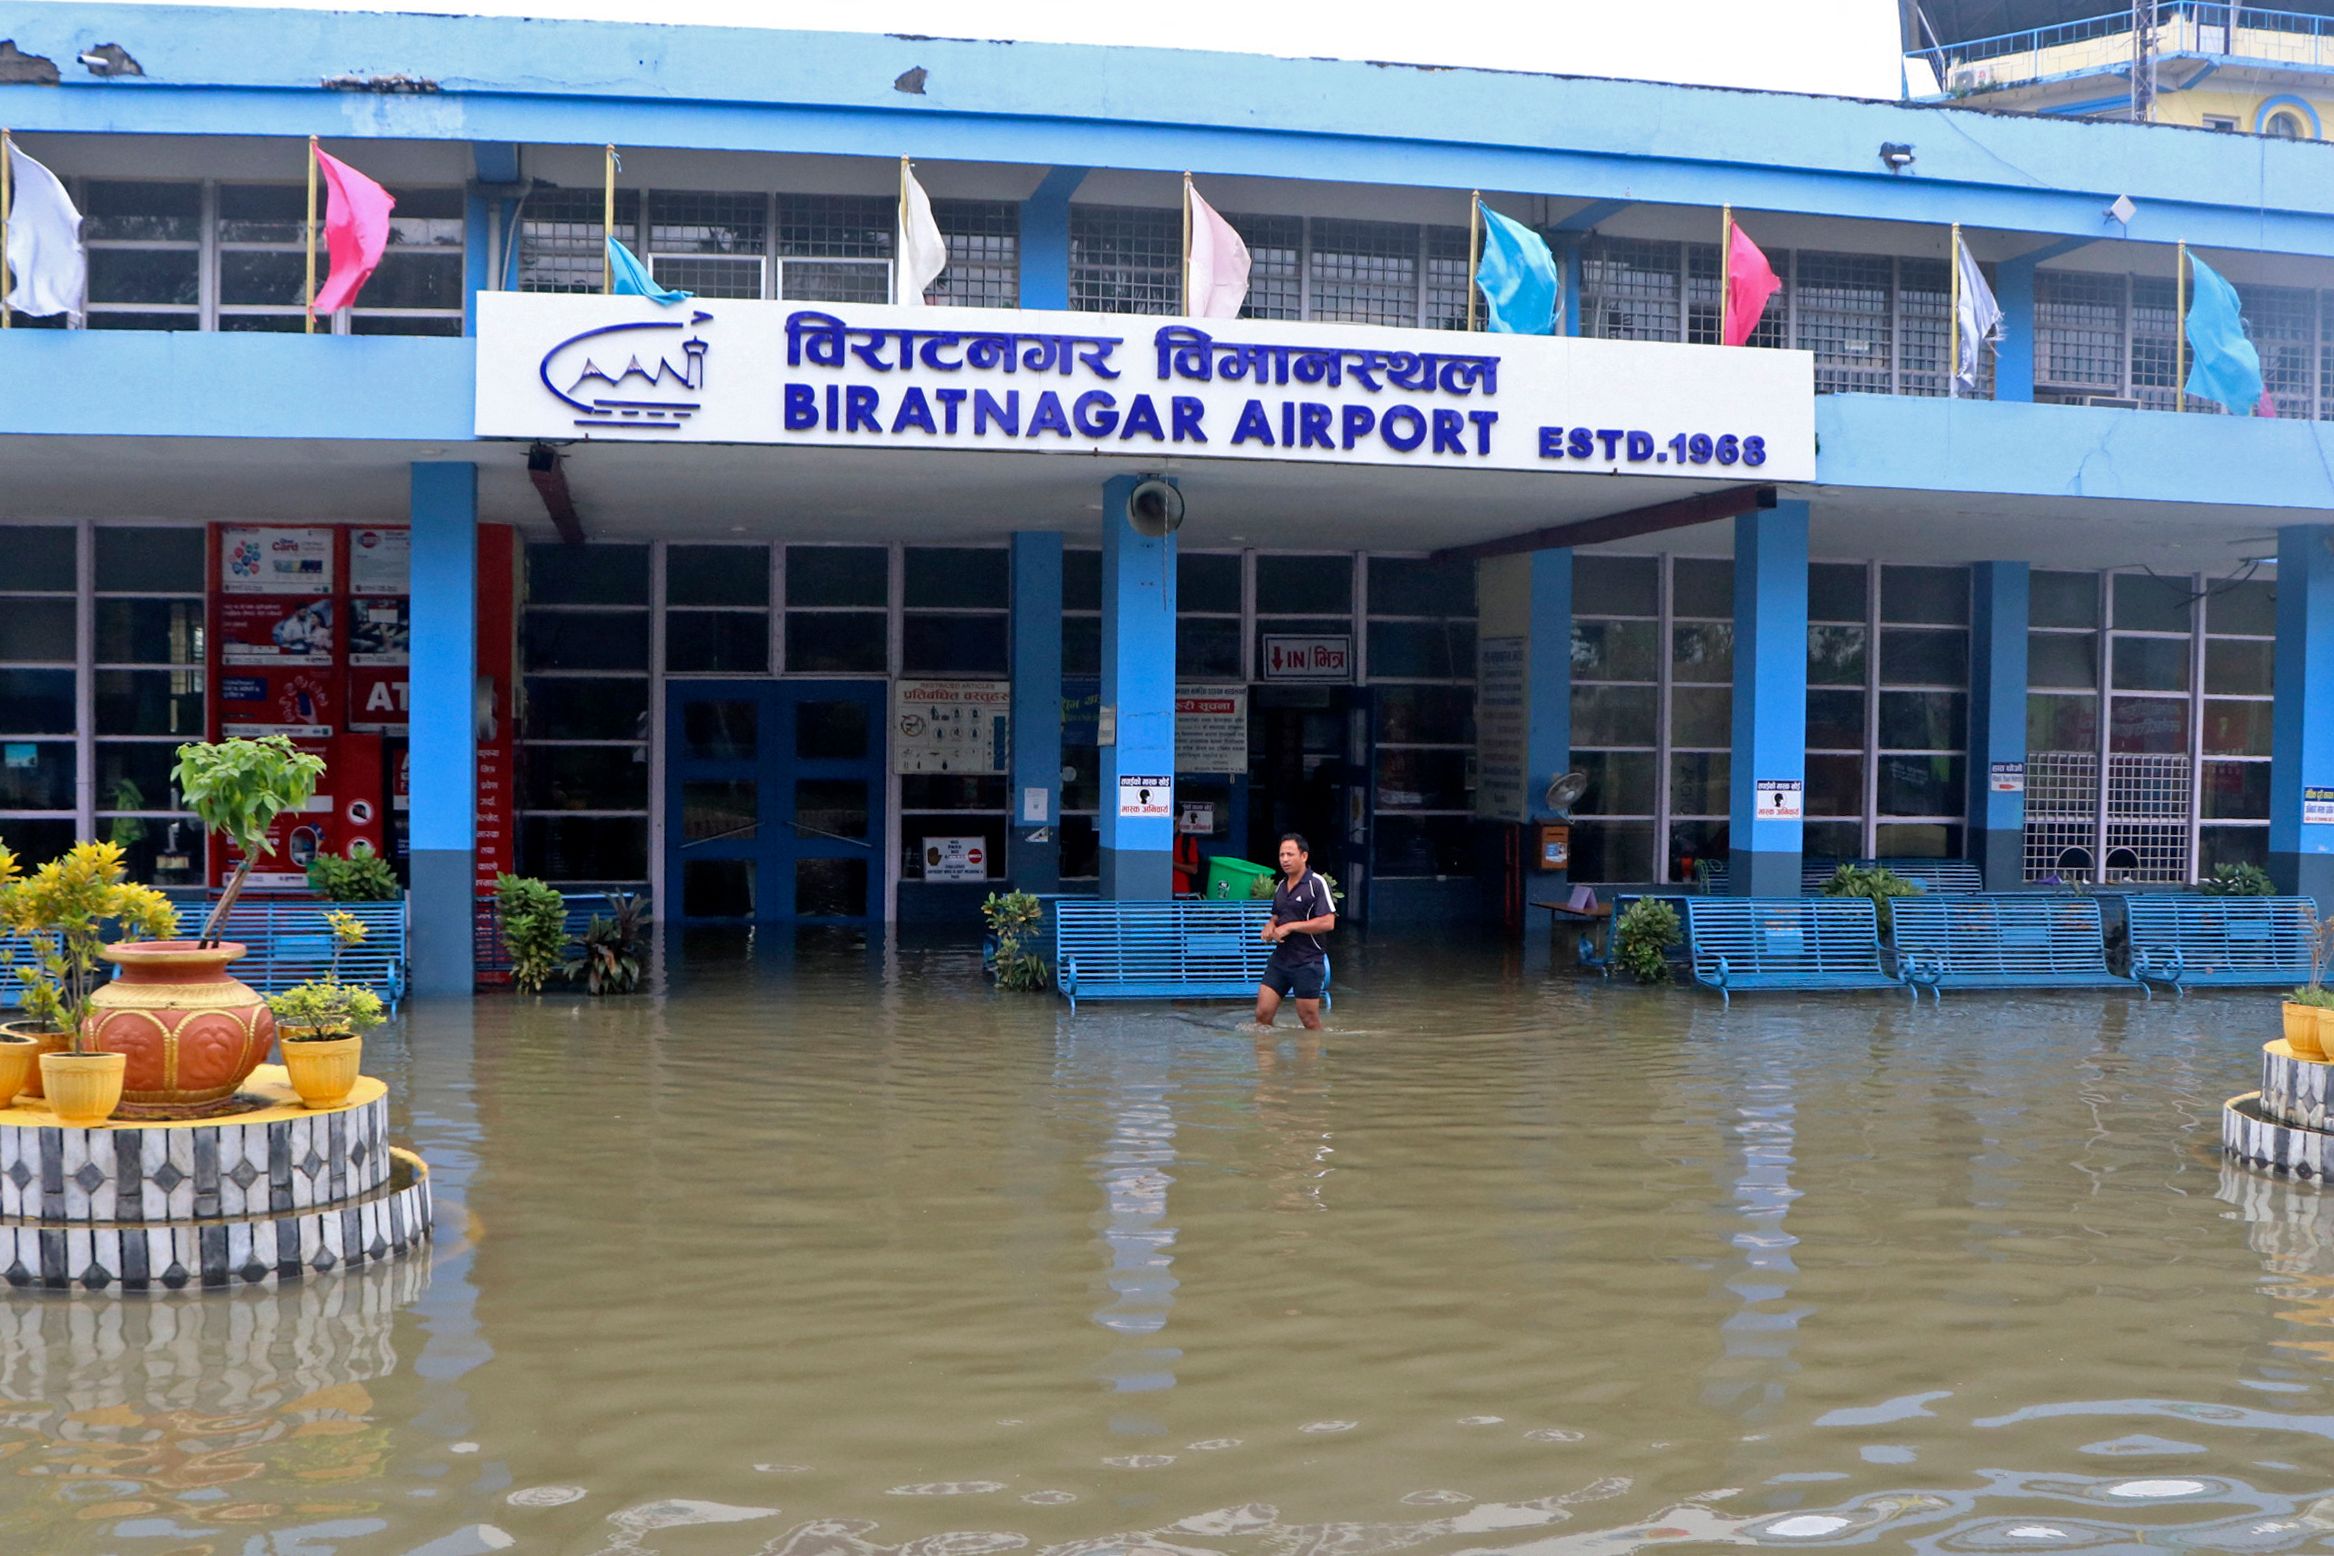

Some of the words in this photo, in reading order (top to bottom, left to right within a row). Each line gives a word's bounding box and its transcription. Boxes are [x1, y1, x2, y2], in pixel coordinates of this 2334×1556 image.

[785, 311, 1124, 379] विराटनगर
[1154, 325, 1501, 395] विमानस्थल
[784, 383, 1208, 443] BIRATNAGAR
[1231, 399, 1499, 456] AIRPORT
[1538, 426, 1766, 467] ESTD.1968
[1198, 701, 1231, 713] सूचना
[1121, 805, 1140, 813] मास्क
